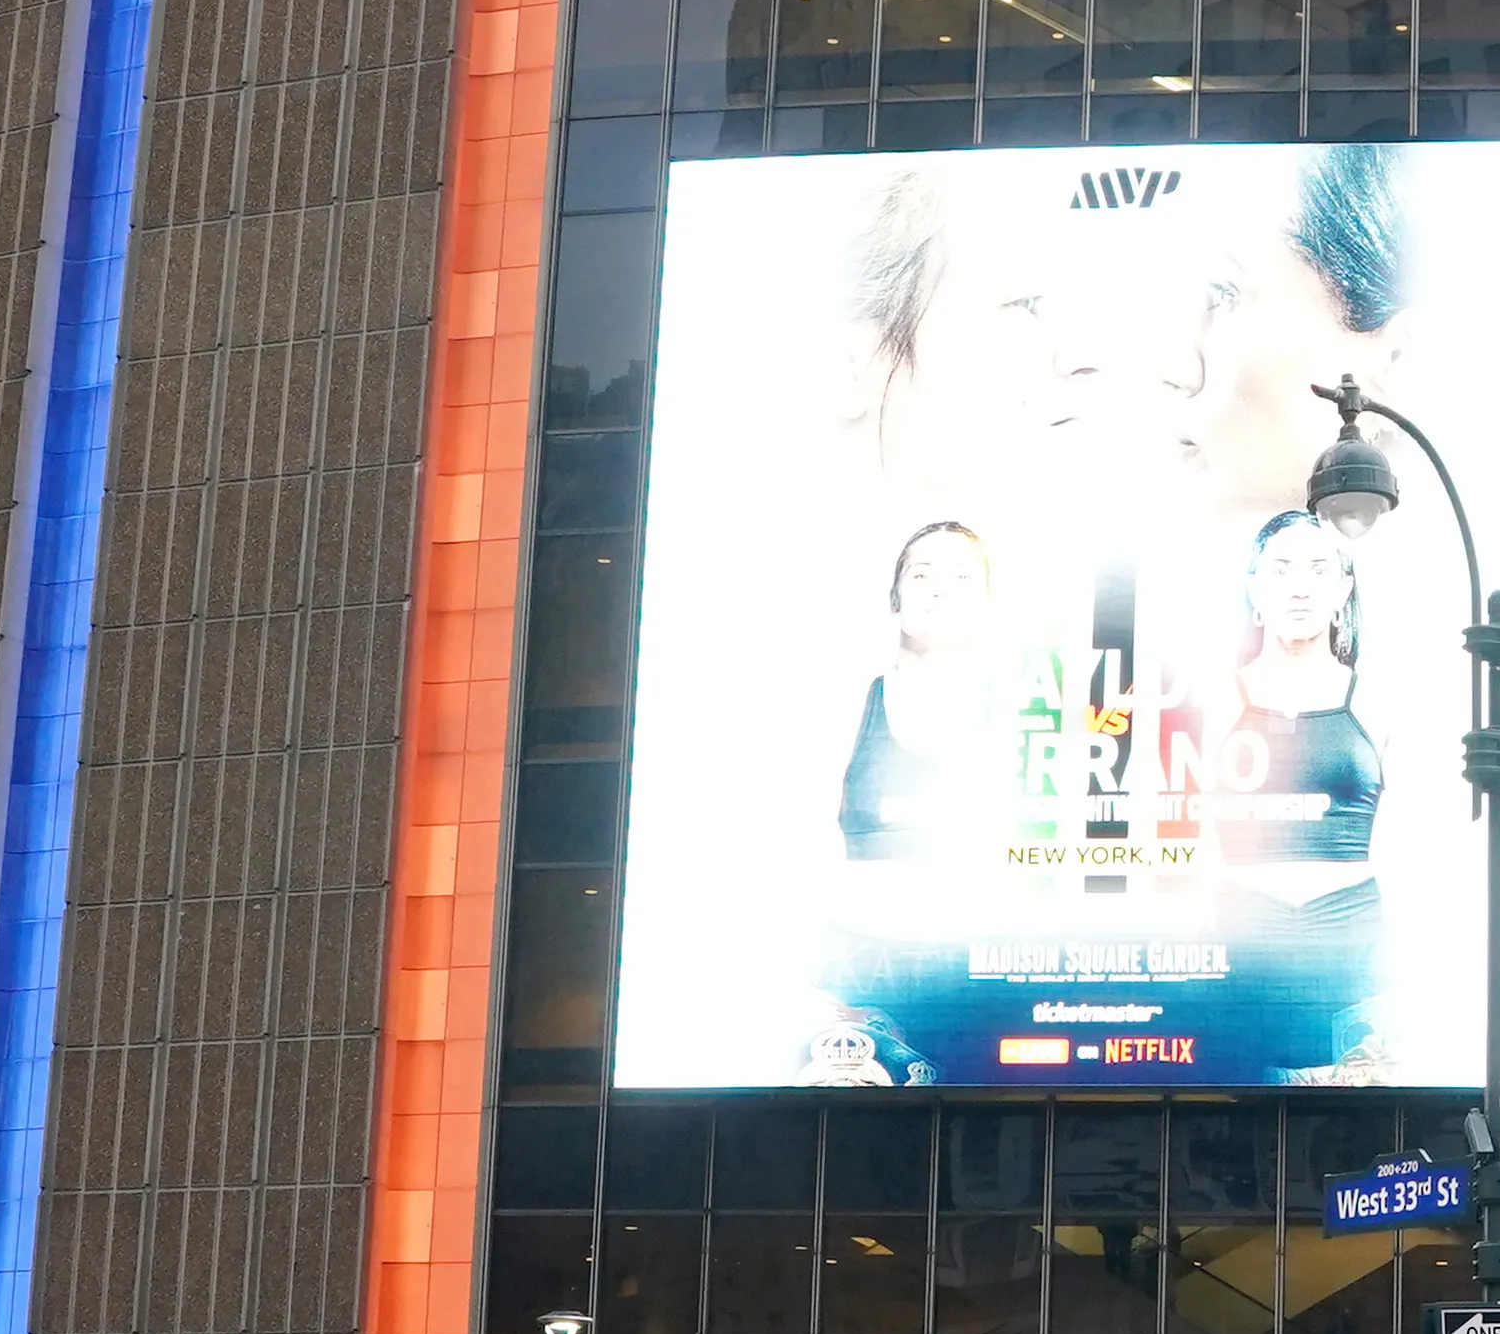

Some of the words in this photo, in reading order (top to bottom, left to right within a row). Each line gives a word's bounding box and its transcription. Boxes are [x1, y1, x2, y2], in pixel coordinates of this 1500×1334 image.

[1086, 701, 1131, 736] VS
[1008, 847, 1066, 864] NEW
[1076, 846, 1152, 867] YORK,
[1162, 847, 1196, 864] NY
[1105, 1038, 1194, 1064] NETFLIX
[1377, 1165, 1394, 1179] 200
[1399, 1161, 1418, 1174] 270
[1337, 1190, 1388, 1220] West
[1393, 1179, 1431, 1214] 33rd
[1437, 1175, 1458, 1207] St
